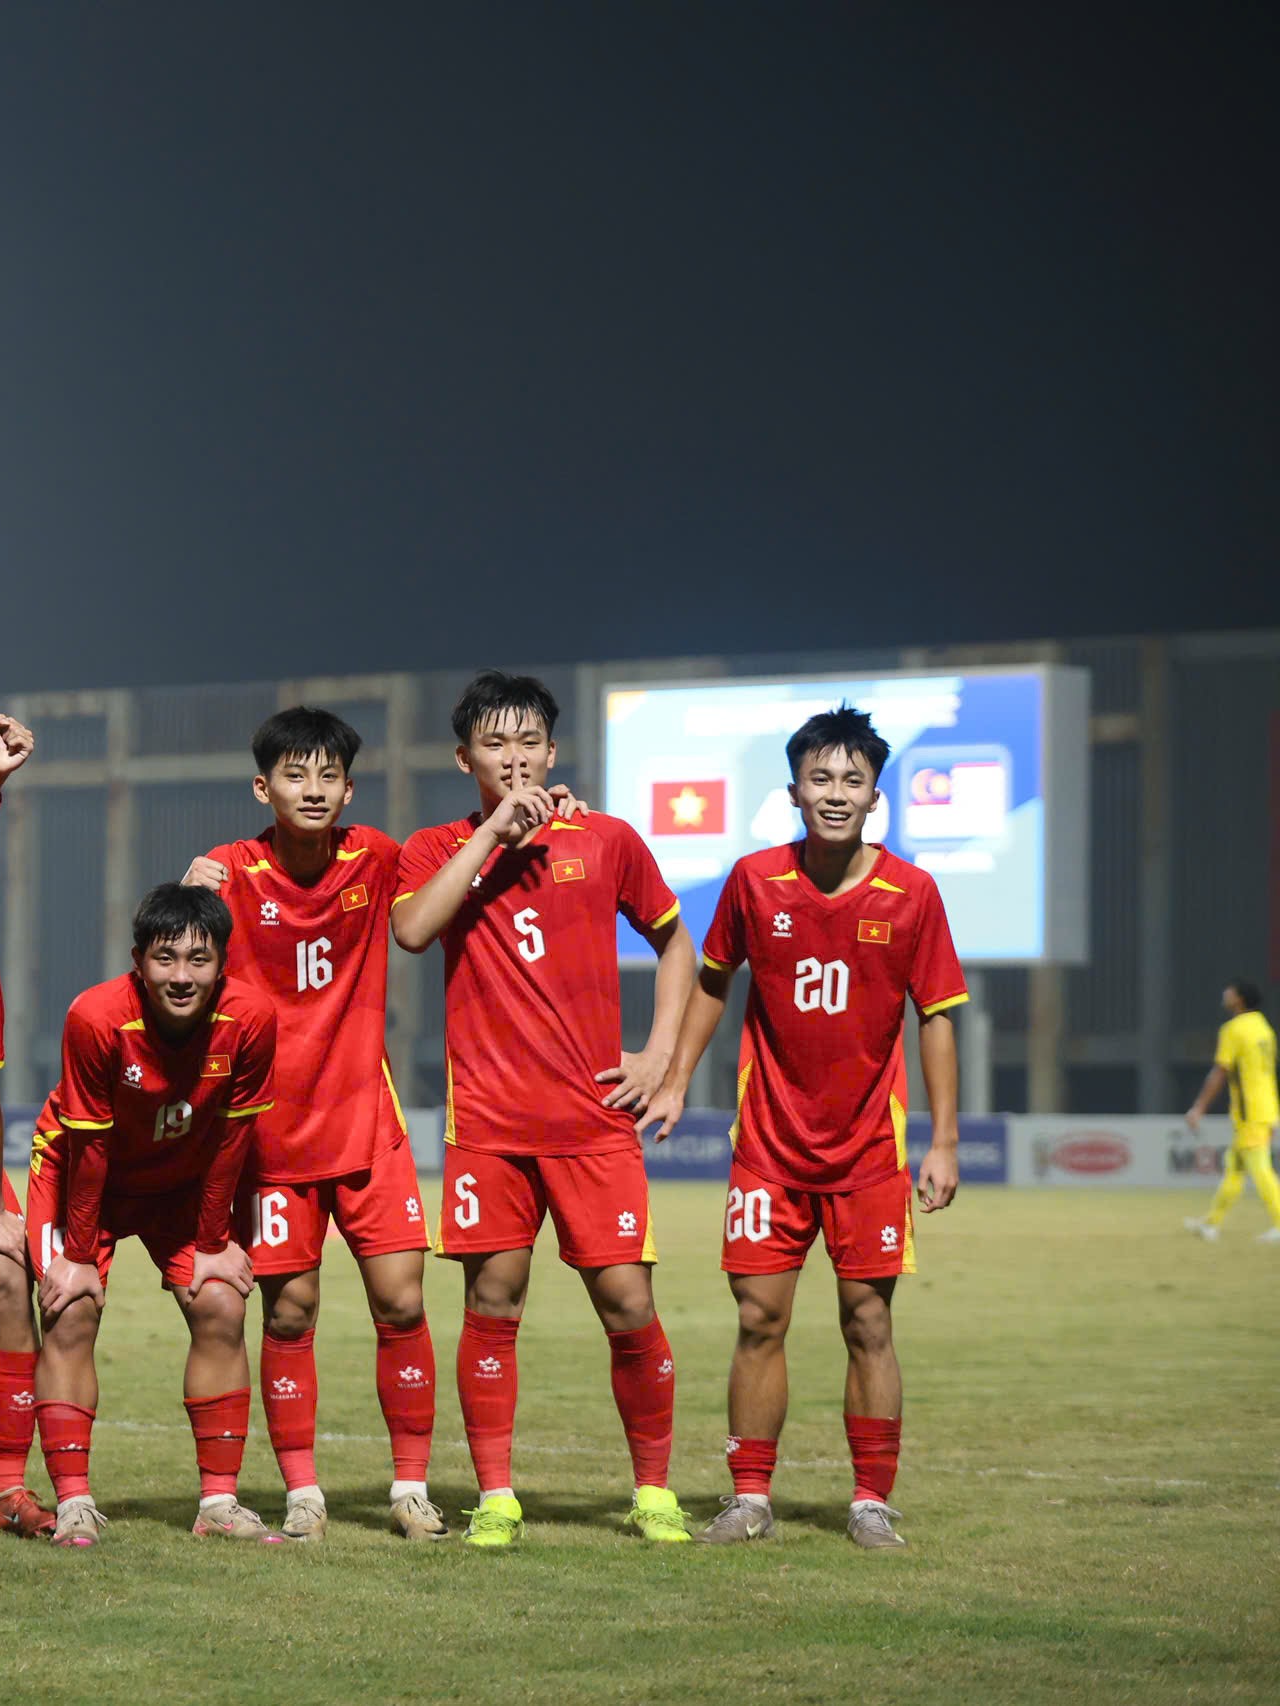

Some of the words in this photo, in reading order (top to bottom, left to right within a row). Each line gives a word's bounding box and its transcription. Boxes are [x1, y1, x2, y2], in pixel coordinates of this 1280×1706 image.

[513, 906, 546, 963] 5
[296, 936, 333, 993] 16
[793, 957, 850, 1016] 20
[153, 1100, 192, 1142] 19
[252, 1191, 289, 1249] 16
[454, 1172, 480, 1230] 5
[726, 1186, 772, 1244] 20
